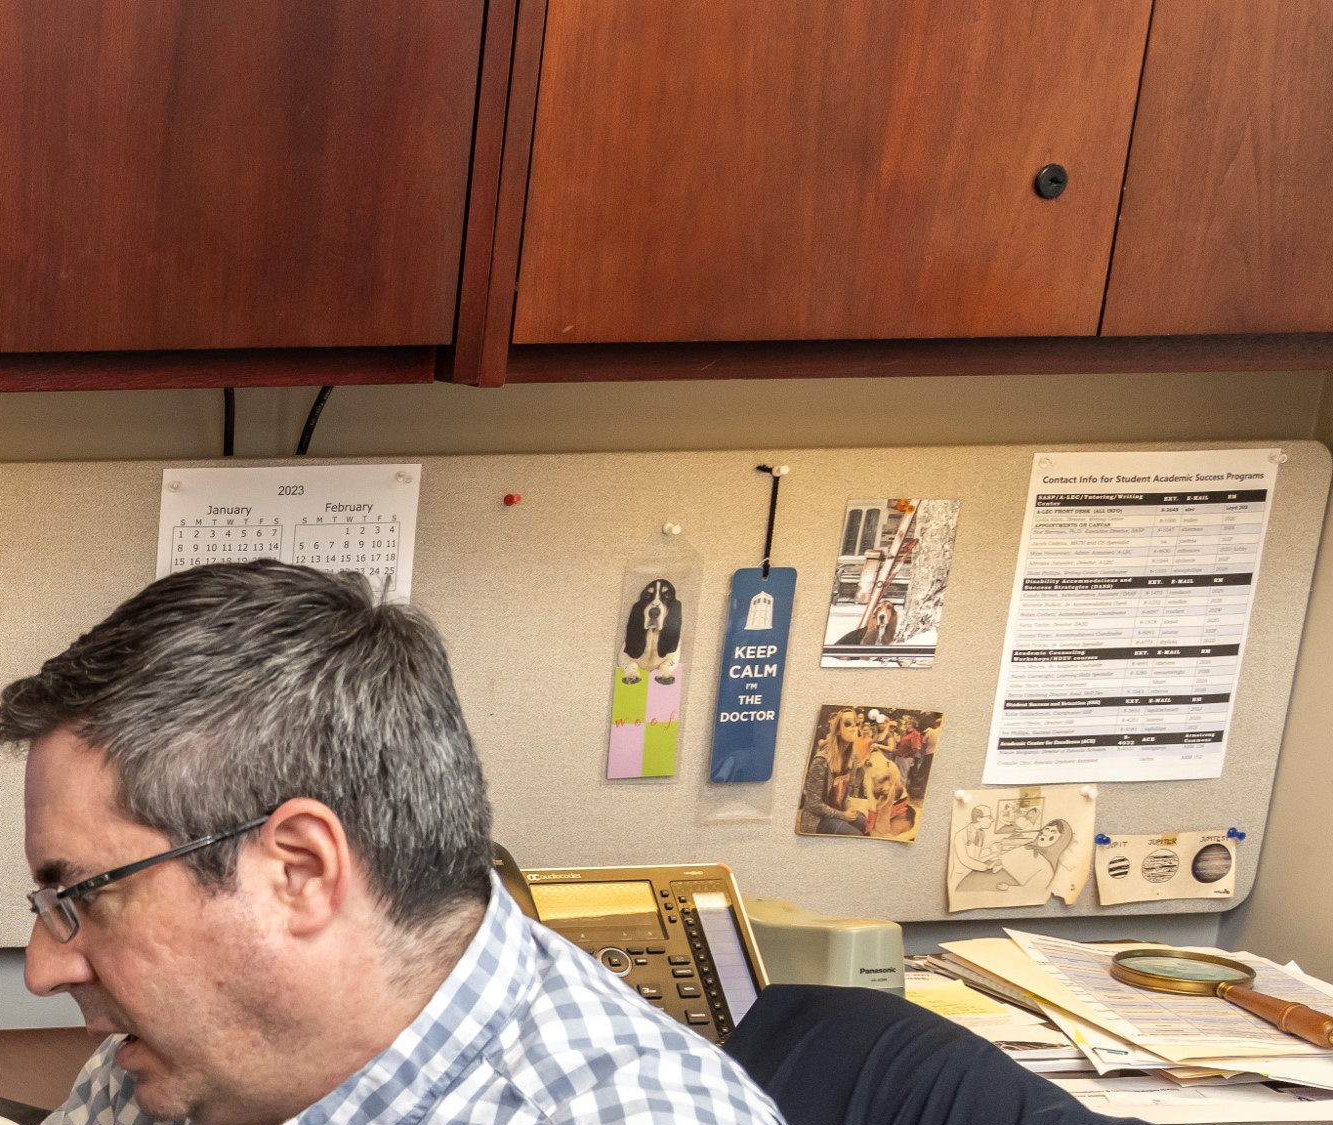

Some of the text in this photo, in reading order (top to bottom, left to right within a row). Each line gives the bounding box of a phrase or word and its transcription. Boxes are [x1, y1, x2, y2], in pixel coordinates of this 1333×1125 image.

[1043, 472, 1264, 484] Contact Info for Student Academic Success Programs
[278, 485, 305, 496] 2023
[207, 506, 252, 516] January
[325, 503, 373, 513] February
[734, 645, 778, 659] KEEP
[729, 664, 777, 678] CALM
[738, 695, 762, 705] THE
[720, 710, 776, 723] DOCTOR
[1148, 838, 1177, 846] JUPITER
[860, 967, 896, 975] Panasonic
